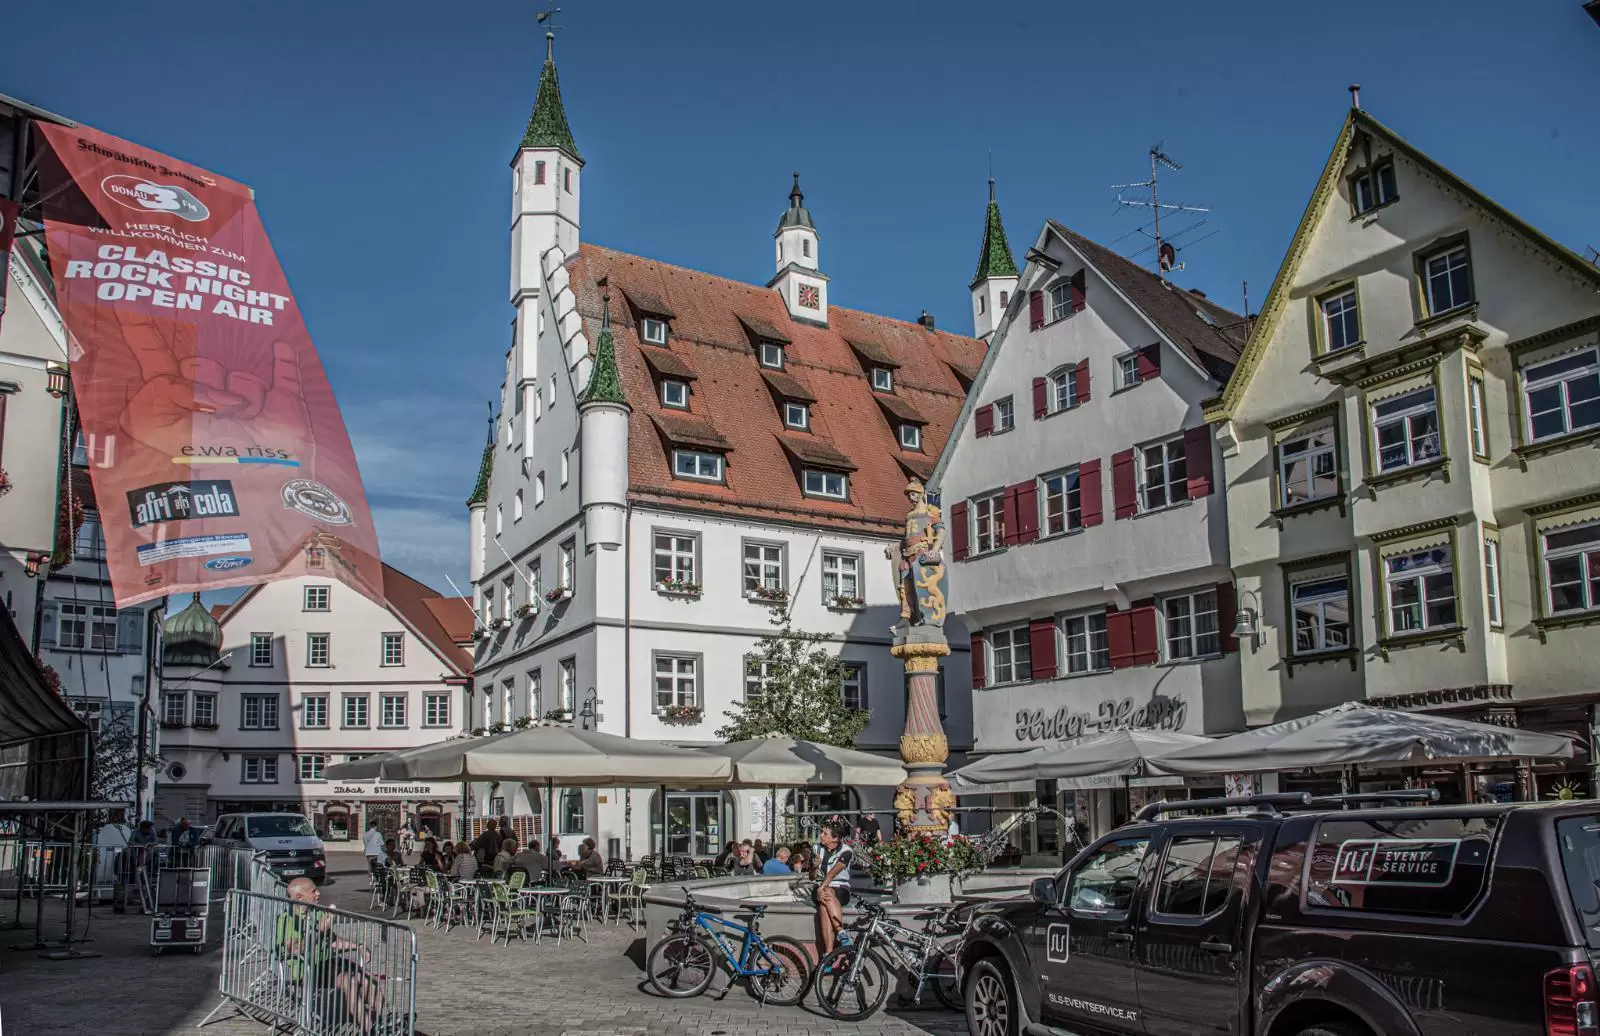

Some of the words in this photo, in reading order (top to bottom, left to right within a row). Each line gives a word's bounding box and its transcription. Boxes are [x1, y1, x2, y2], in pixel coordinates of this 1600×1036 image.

[111, 184, 148, 201] DONAU
[134, 183, 180, 210] 3
[182, 199, 198, 213] FM
[88, 226, 207, 252] WILLKOMMEN
[211, 246, 246, 263] ZUM
[126, 222, 209, 244] HERZLICH
[98, 244, 250, 286] CLASSIC
[64, 260, 174, 289] ROCK
[185, 276, 289, 311] NIGHT
[97, 282, 202, 311] OPEN
[212, 300, 273, 326] AIR
[181, 445, 240, 457] e.wa
[246, 441, 289, 459] riss
[136, 491, 172, 524] afri
[193, 485, 234, 515] cola
[214, 559, 244, 569] Ford
[333, 786, 366, 794] Tabak
[373, 786, 431, 794] STEINHAUSER
[1382, 862, 1438, 873] SERVICE
[1385, 851, 1426, 861] EVENT
[1048, 993, 1137, 1021] SLS-EVENTSERVICE.AT
